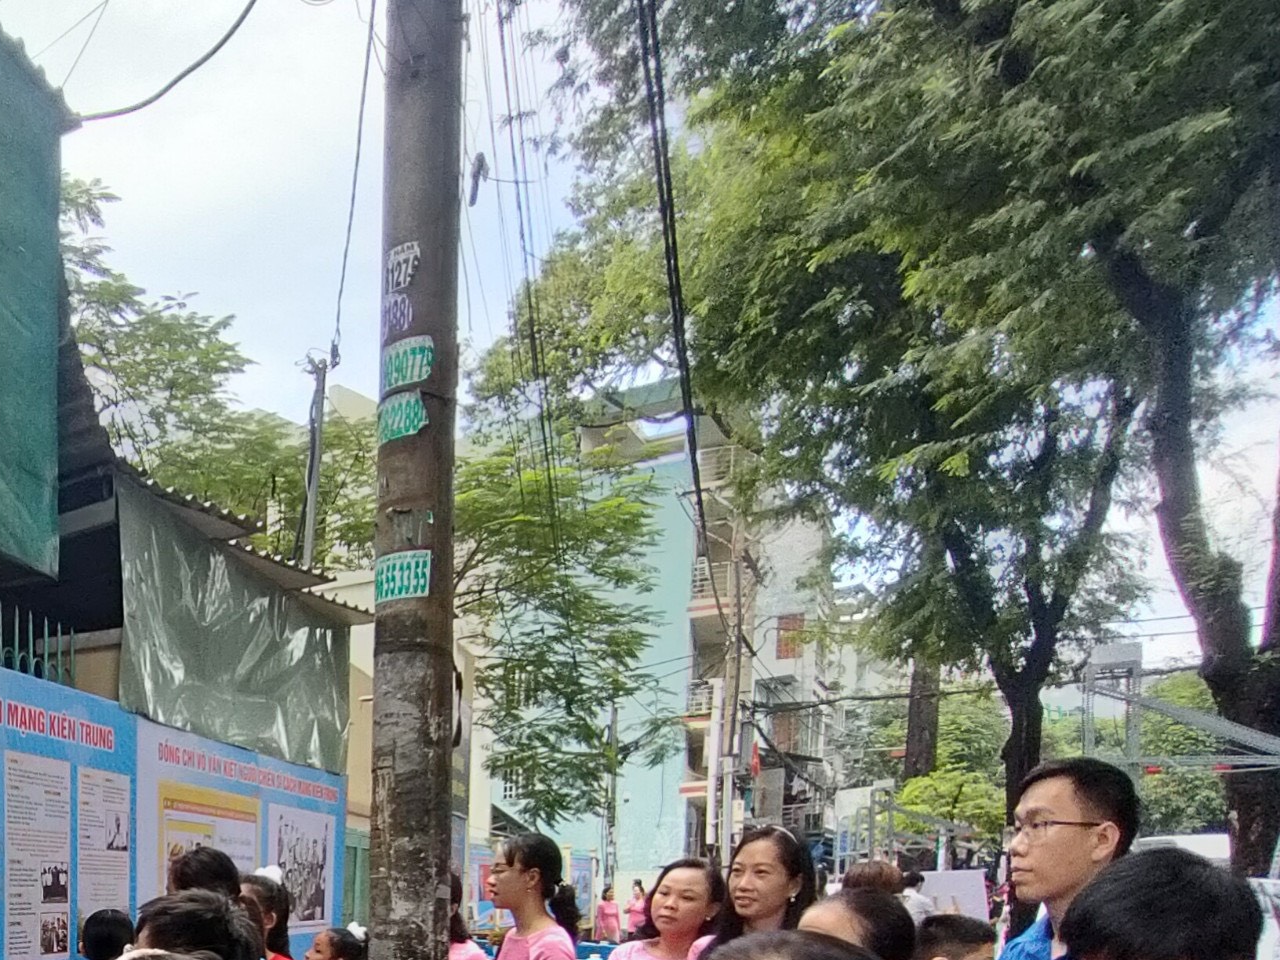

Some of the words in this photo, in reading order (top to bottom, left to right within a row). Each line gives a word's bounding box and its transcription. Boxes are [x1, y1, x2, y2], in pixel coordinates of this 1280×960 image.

[7, 706, 46, 737] MẠNG
[49, 710, 77, 740] KIÊN
[79, 721, 114, 751] TRUNG
